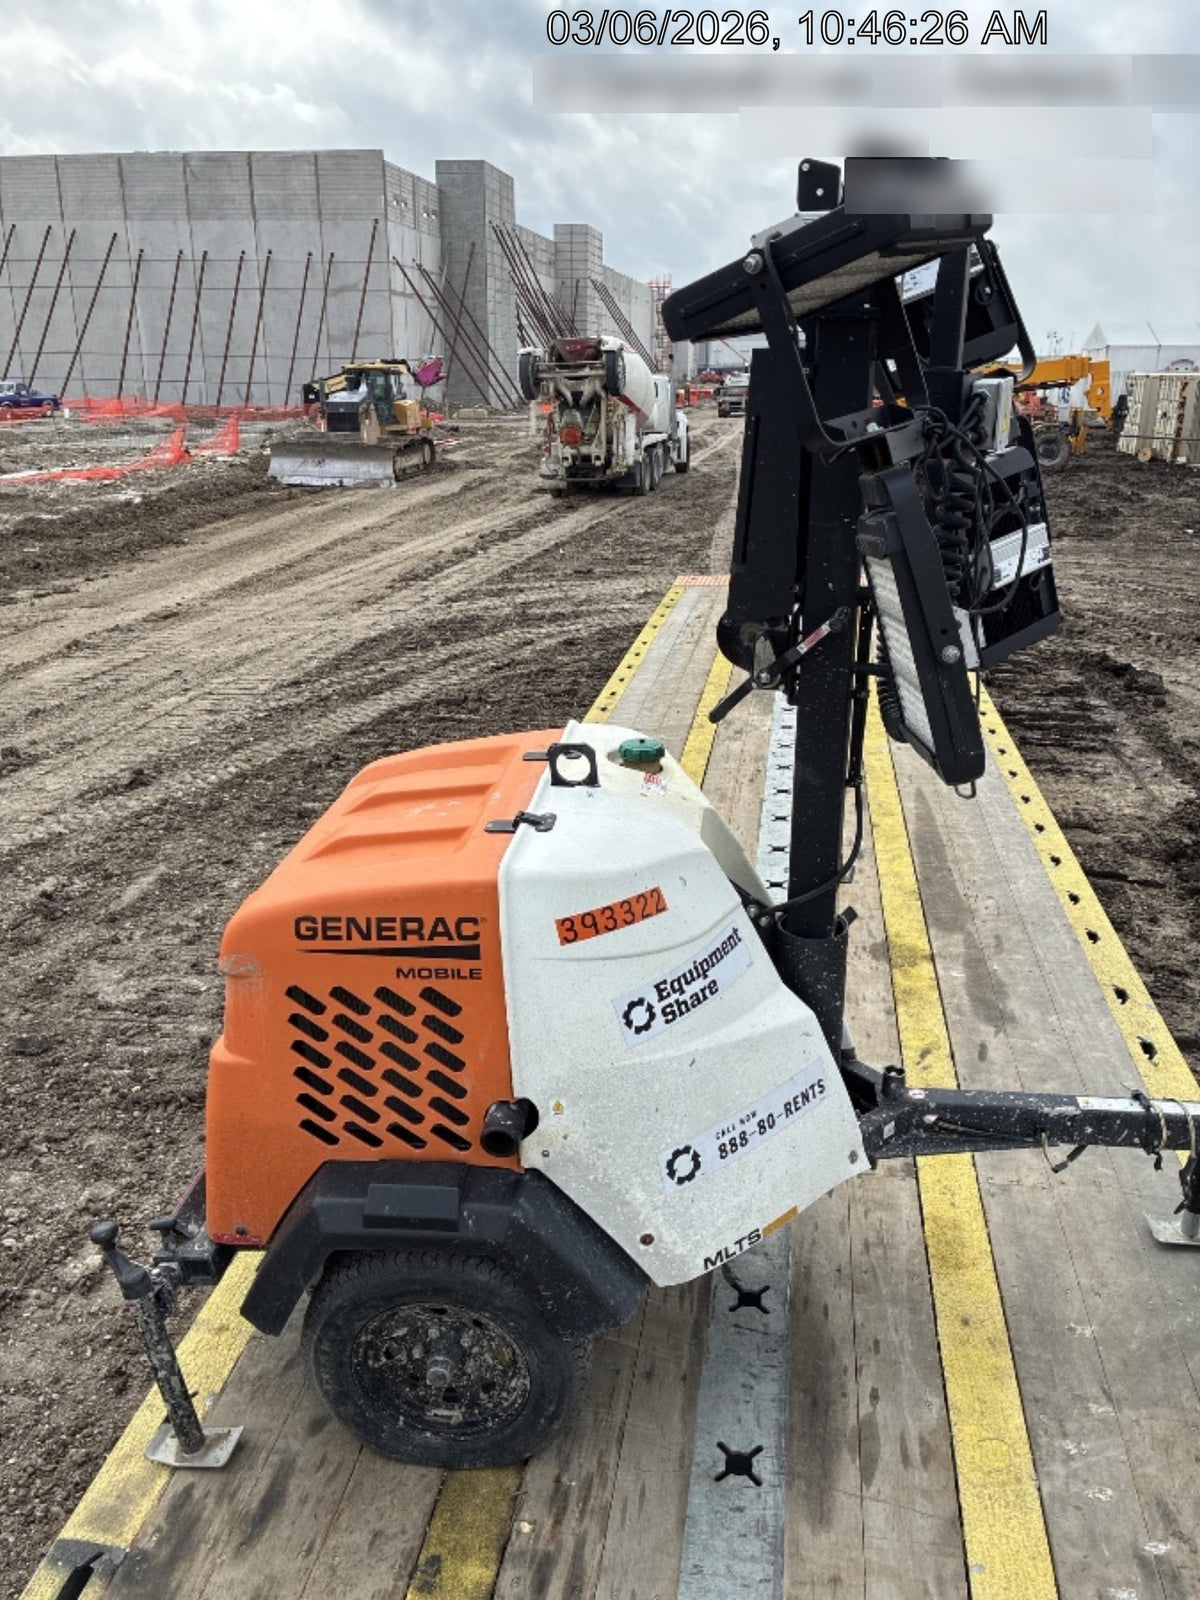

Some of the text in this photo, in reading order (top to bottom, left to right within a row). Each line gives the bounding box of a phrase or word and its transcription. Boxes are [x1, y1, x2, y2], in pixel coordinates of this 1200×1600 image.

[294, 916, 481, 941] GENERAC
[560, 888, 665, 943] 393322
[396, 967, 482, 980] MOBILE
[654, 926, 742, 1003] Equipment
[661, 978, 719, 1025] Share
[715, 1110, 757, 1140] CALL NOW
[717, 1078, 826, 1160] 888-80-RENTS
[703, 1228, 761, 1270] MLTS
